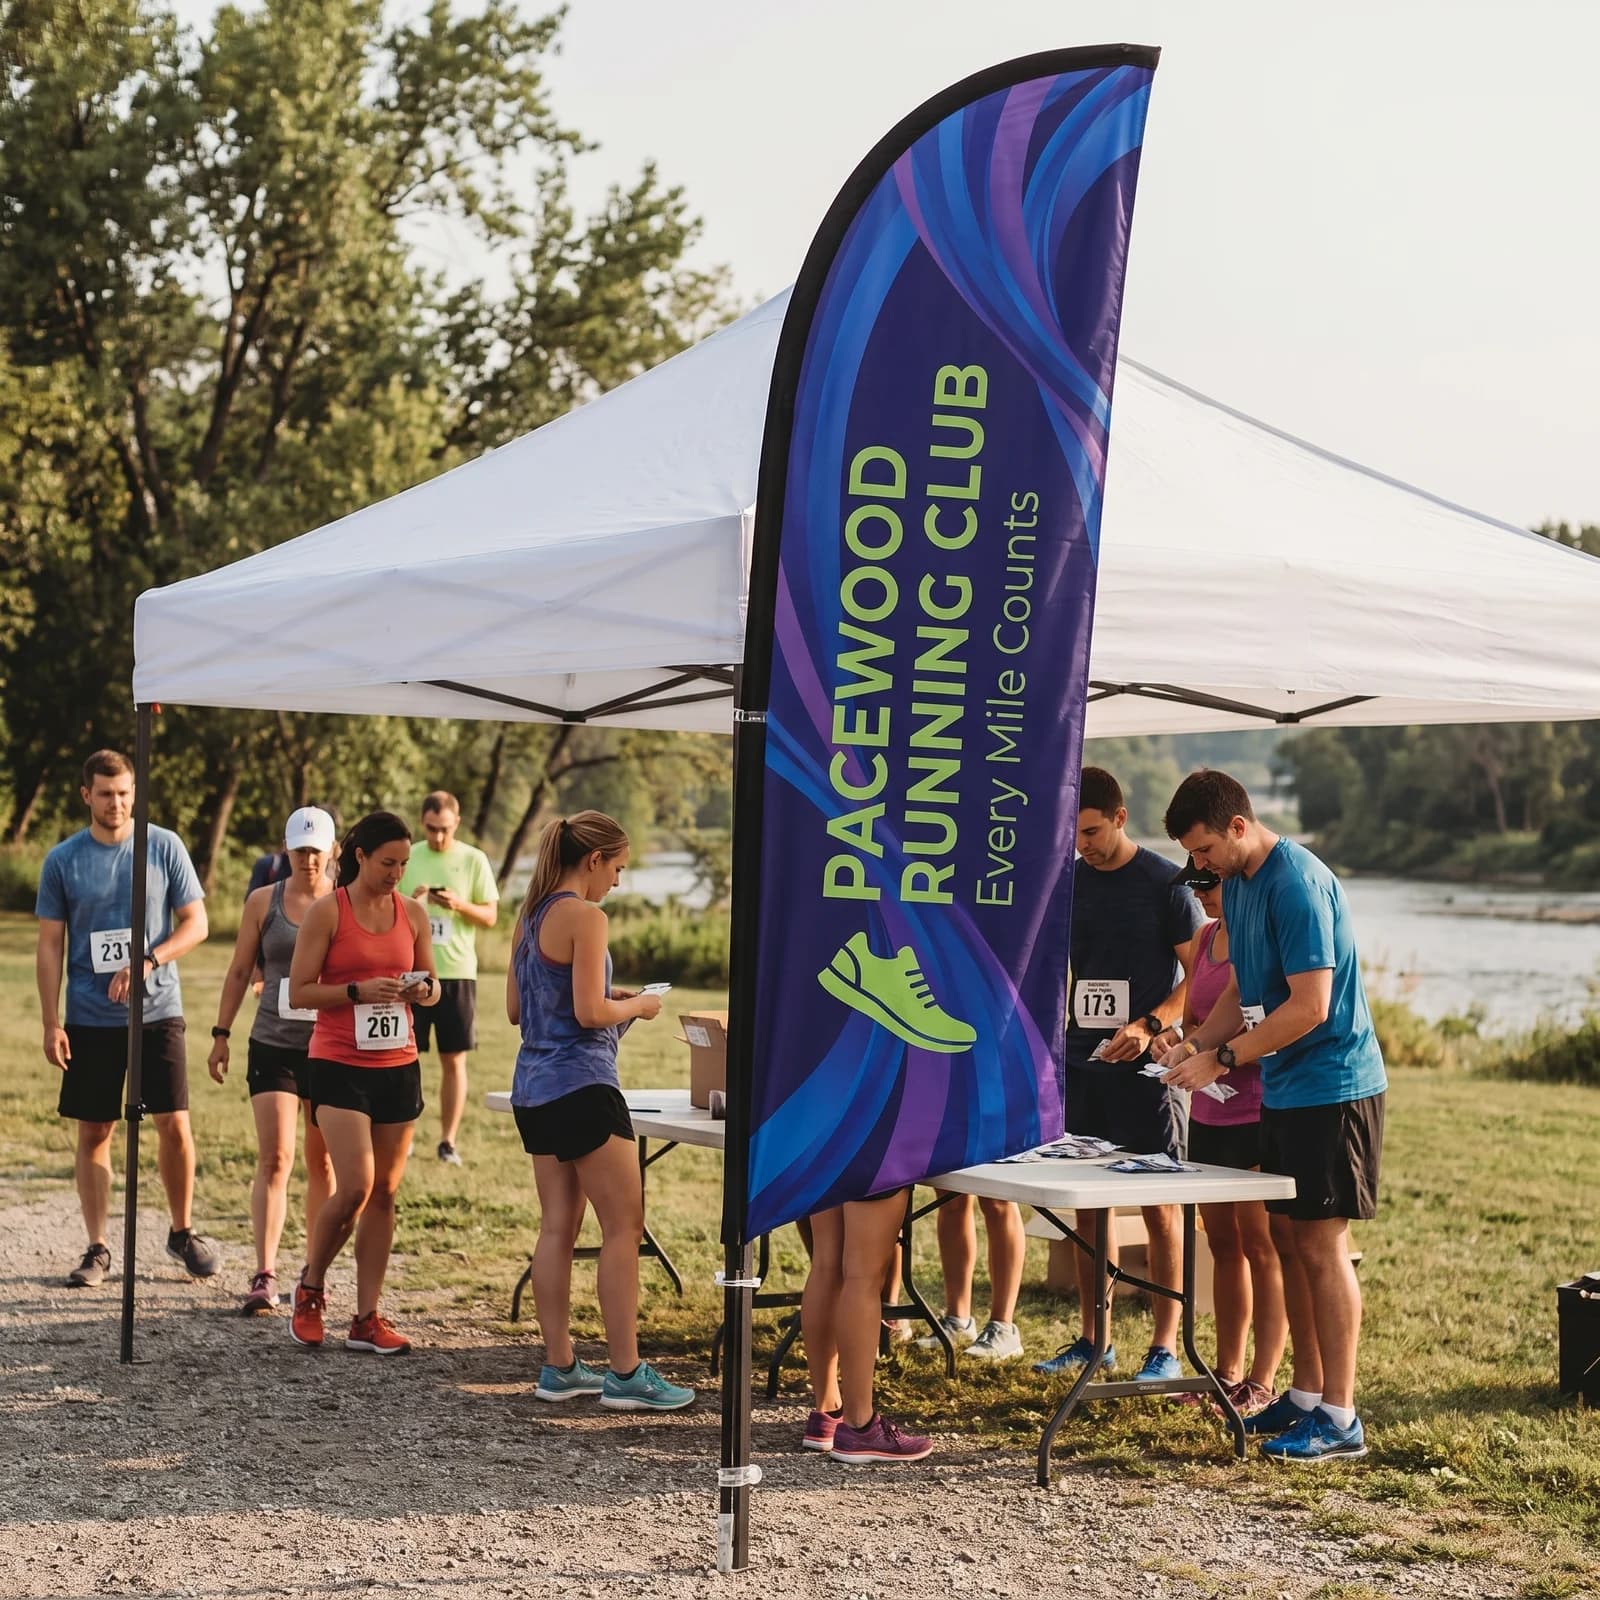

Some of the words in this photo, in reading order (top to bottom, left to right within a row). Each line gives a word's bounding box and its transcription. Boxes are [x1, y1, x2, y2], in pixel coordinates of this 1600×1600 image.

[923, 364, 989, 550] CLUB
[992, 491, 1040, 655] Counts
[822, 445, 907, 901] PACEWOOD
[985, 669, 1026, 763] Mile
[899, 573, 973, 905] RUNNING
[975, 778, 1029, 906] Every
[101, 942, 131, 961] 231
[1083, 994, 1115, 1016] 173
[367, 1016, 399, 1038] 267
